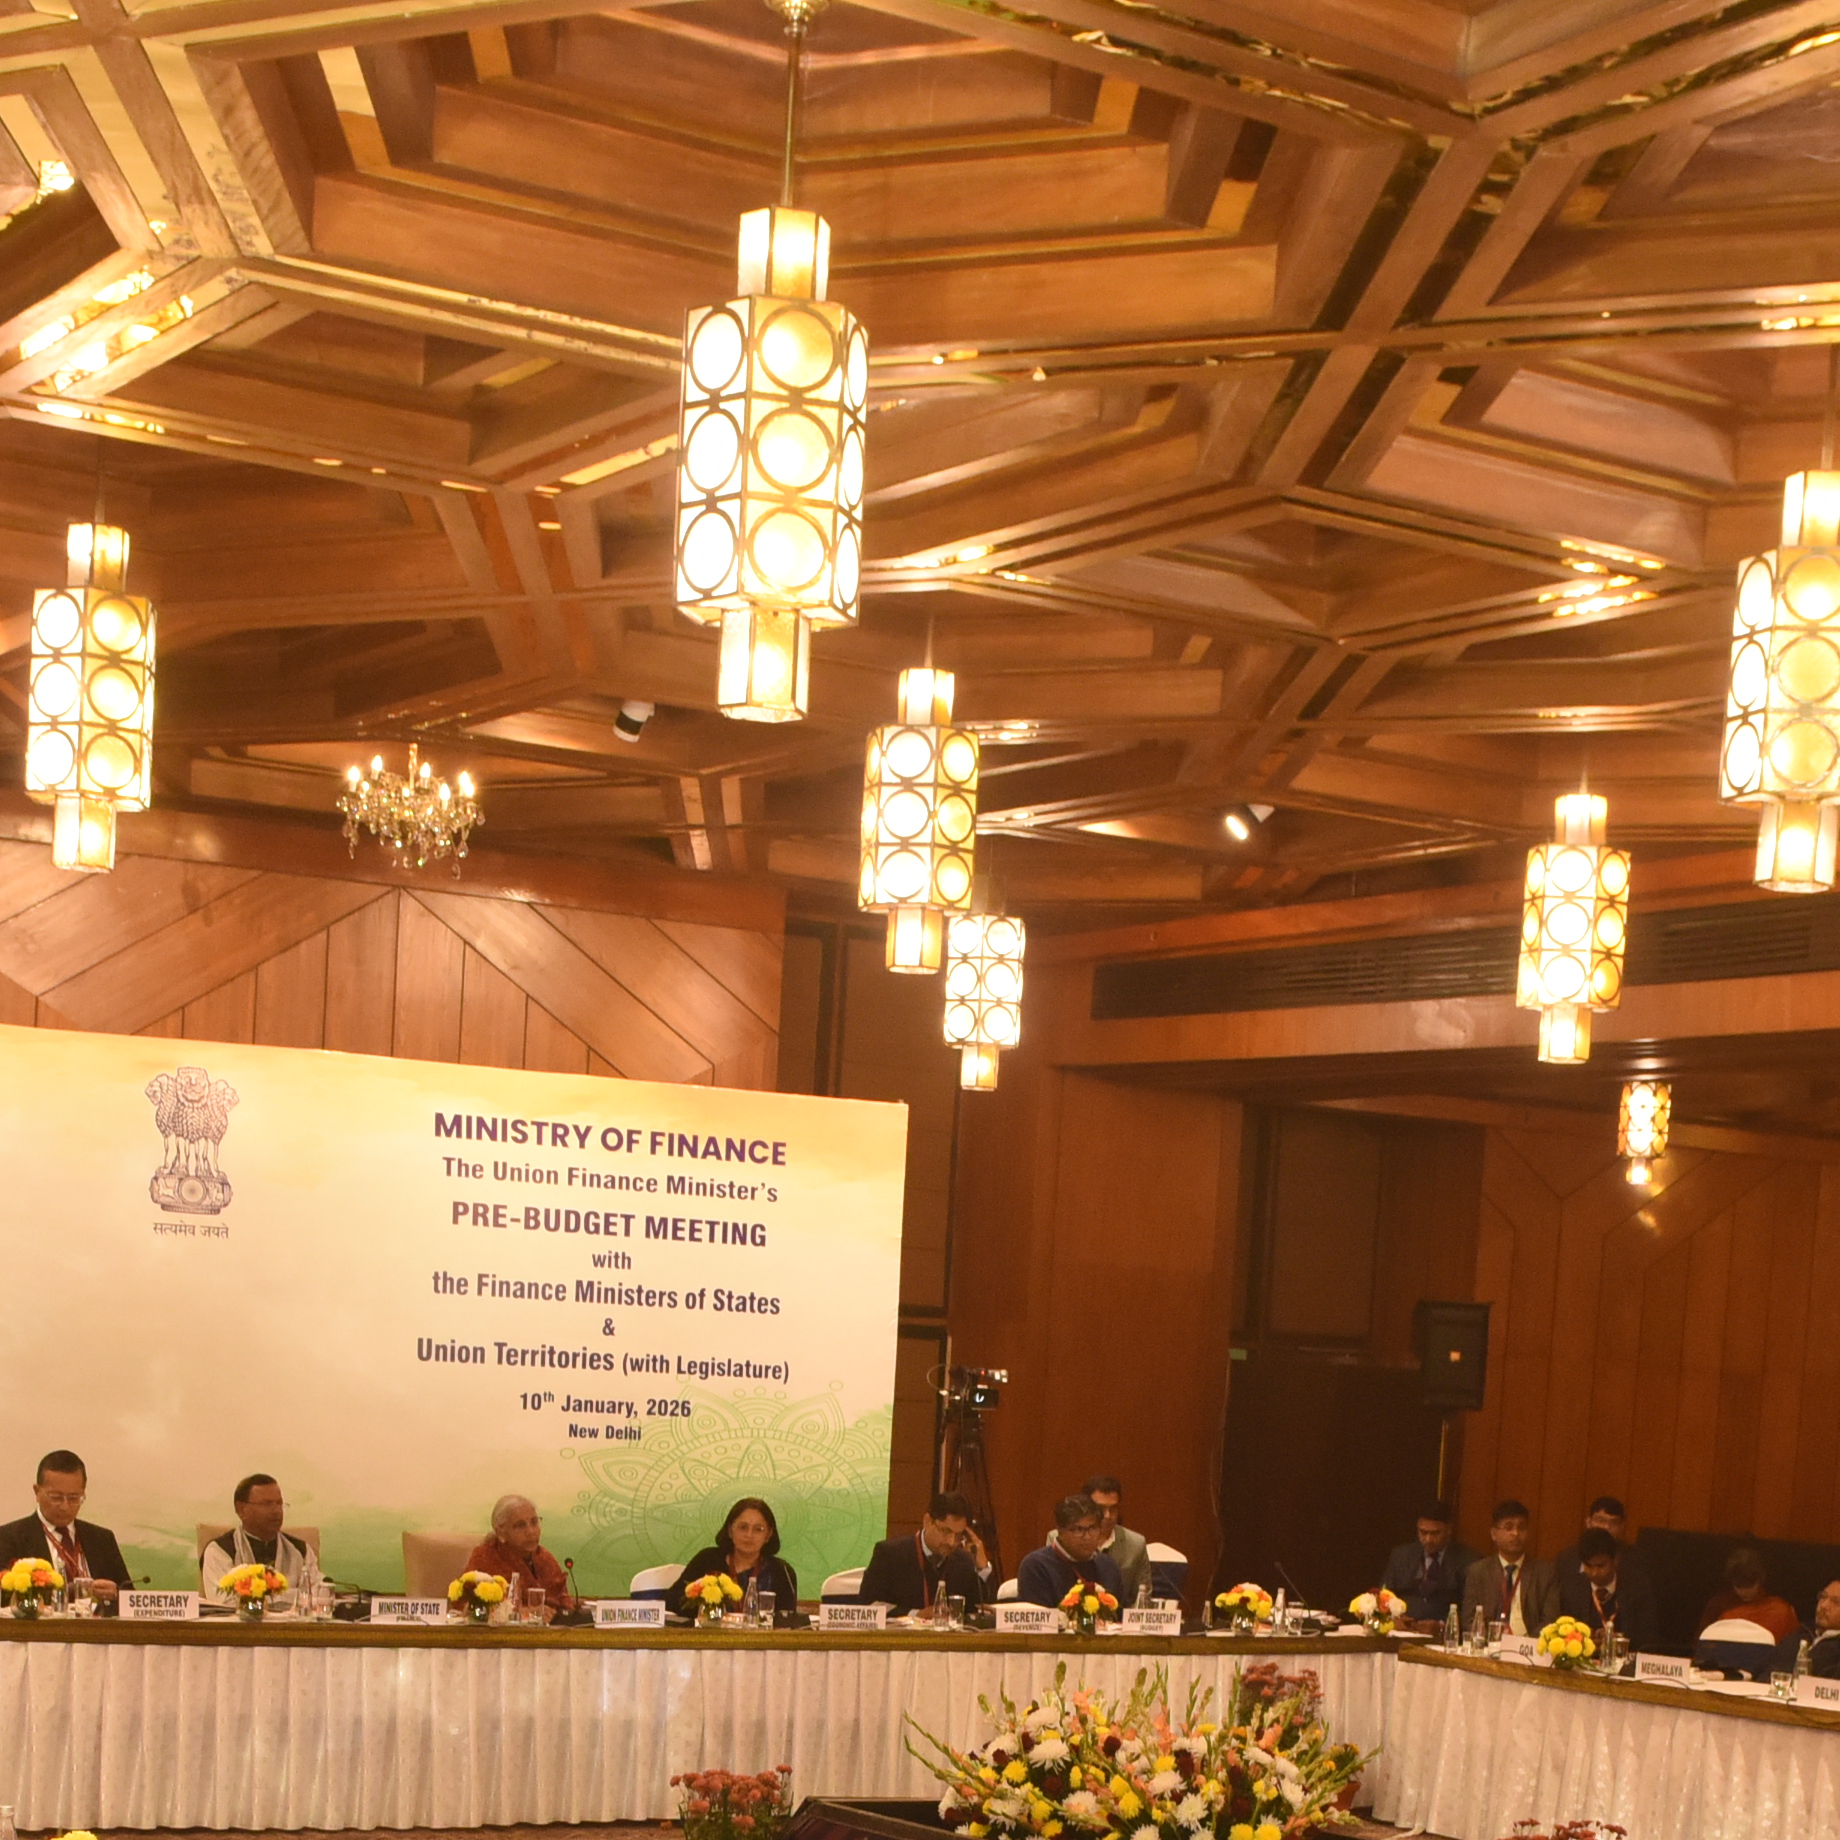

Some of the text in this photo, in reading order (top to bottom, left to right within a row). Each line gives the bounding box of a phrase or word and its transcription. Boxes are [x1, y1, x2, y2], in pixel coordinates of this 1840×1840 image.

[434, 1112, 787, 1166] MINISTRY OF FINANCE
[442, 1156, 778, 1203] The Union Finance Minister’s
[152, 1220, 230, 1239] सत्यमेव जयते
[452, 1201, 766, 1248] PRE-BUDGET MEETING
[591, 1250, 632, 1270] with
[432, 1270, 781, 1315] the Finance Ministers of States
[602, 1317, 616, 1337] &
[417, 1337, 789, 1385] Union Territories (with Legislature)
[519, 1391, 692, 1419] 10th January, 2026
[568, 1423, 642, 1442] New Delhi
[129, 1594, 189, 1608] SECRETARY
[410, 1603, 419, 1614] OF
[420, 1603, 440, 1615] STATE
[134, 1609, 186, 1618] (EXPENDITURE)
[827, 1608, 878, 1621] SECRETARY
[1003, 1611, 1052, 1623] SECRETARY
[1145, 1612, 1177, 1625] SECRETARY
[1519, 1644, 1534, 1656] GOA
[1640, 1661, 1683, 1678] MEGHALAYA
[1814, 1685, 1840, 1701] DELHI
